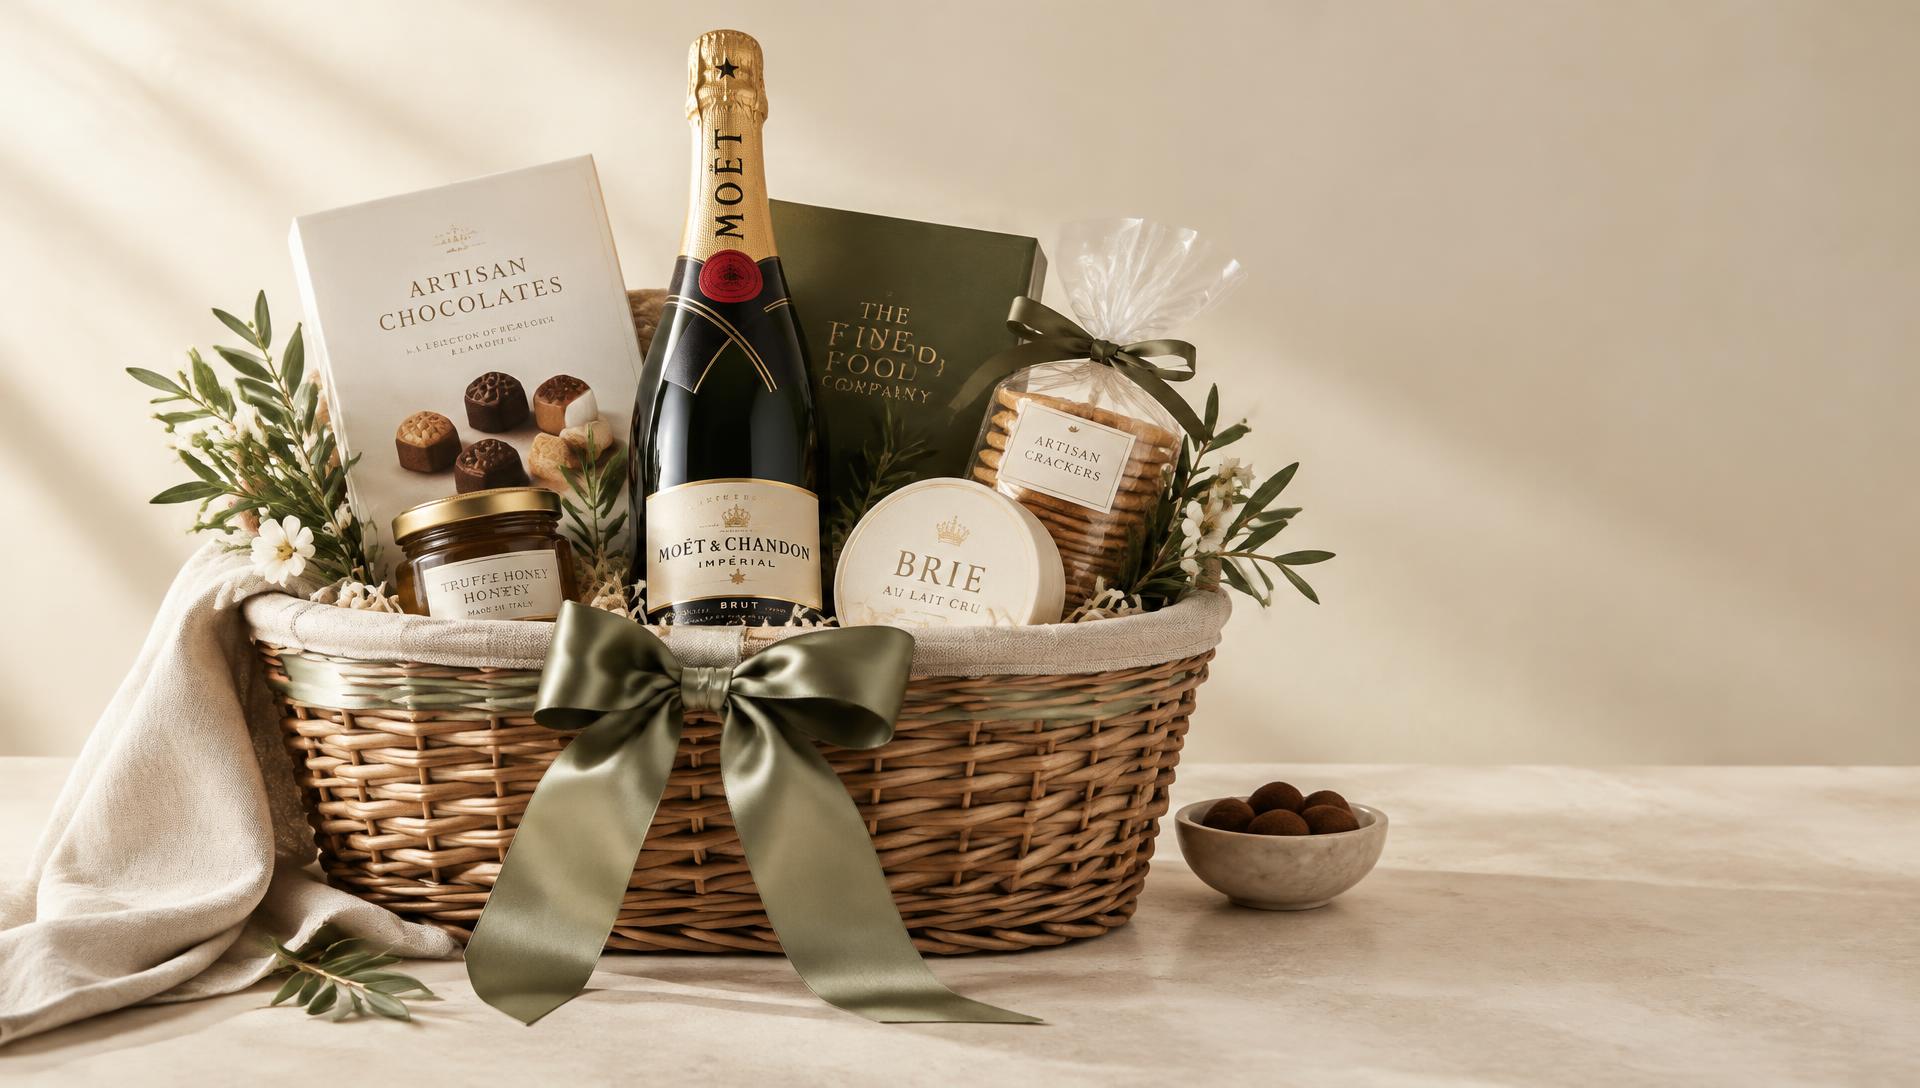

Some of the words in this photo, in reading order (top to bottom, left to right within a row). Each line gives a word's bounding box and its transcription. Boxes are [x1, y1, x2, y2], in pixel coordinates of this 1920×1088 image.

[410, 257, 527, 298] ARTISAN
[379, 276, 563, 331] CHOCOLATES
[860, 302, 910, 325] THE
[1035, 436, 1101, 463] ARTISAN
[1025, 450, 1101, 481] CRACKERS
[710, 540, 721, 552] &
[725, 536, 810, 561] CHANDON
[893, 550, 986, 594] BRIE
[720, 601, 759, 609] BRUT
[883, 585, 904, 598] AU
[910, 591, 945, 605] LAIT
[949, 598, 982, 614] CRU
